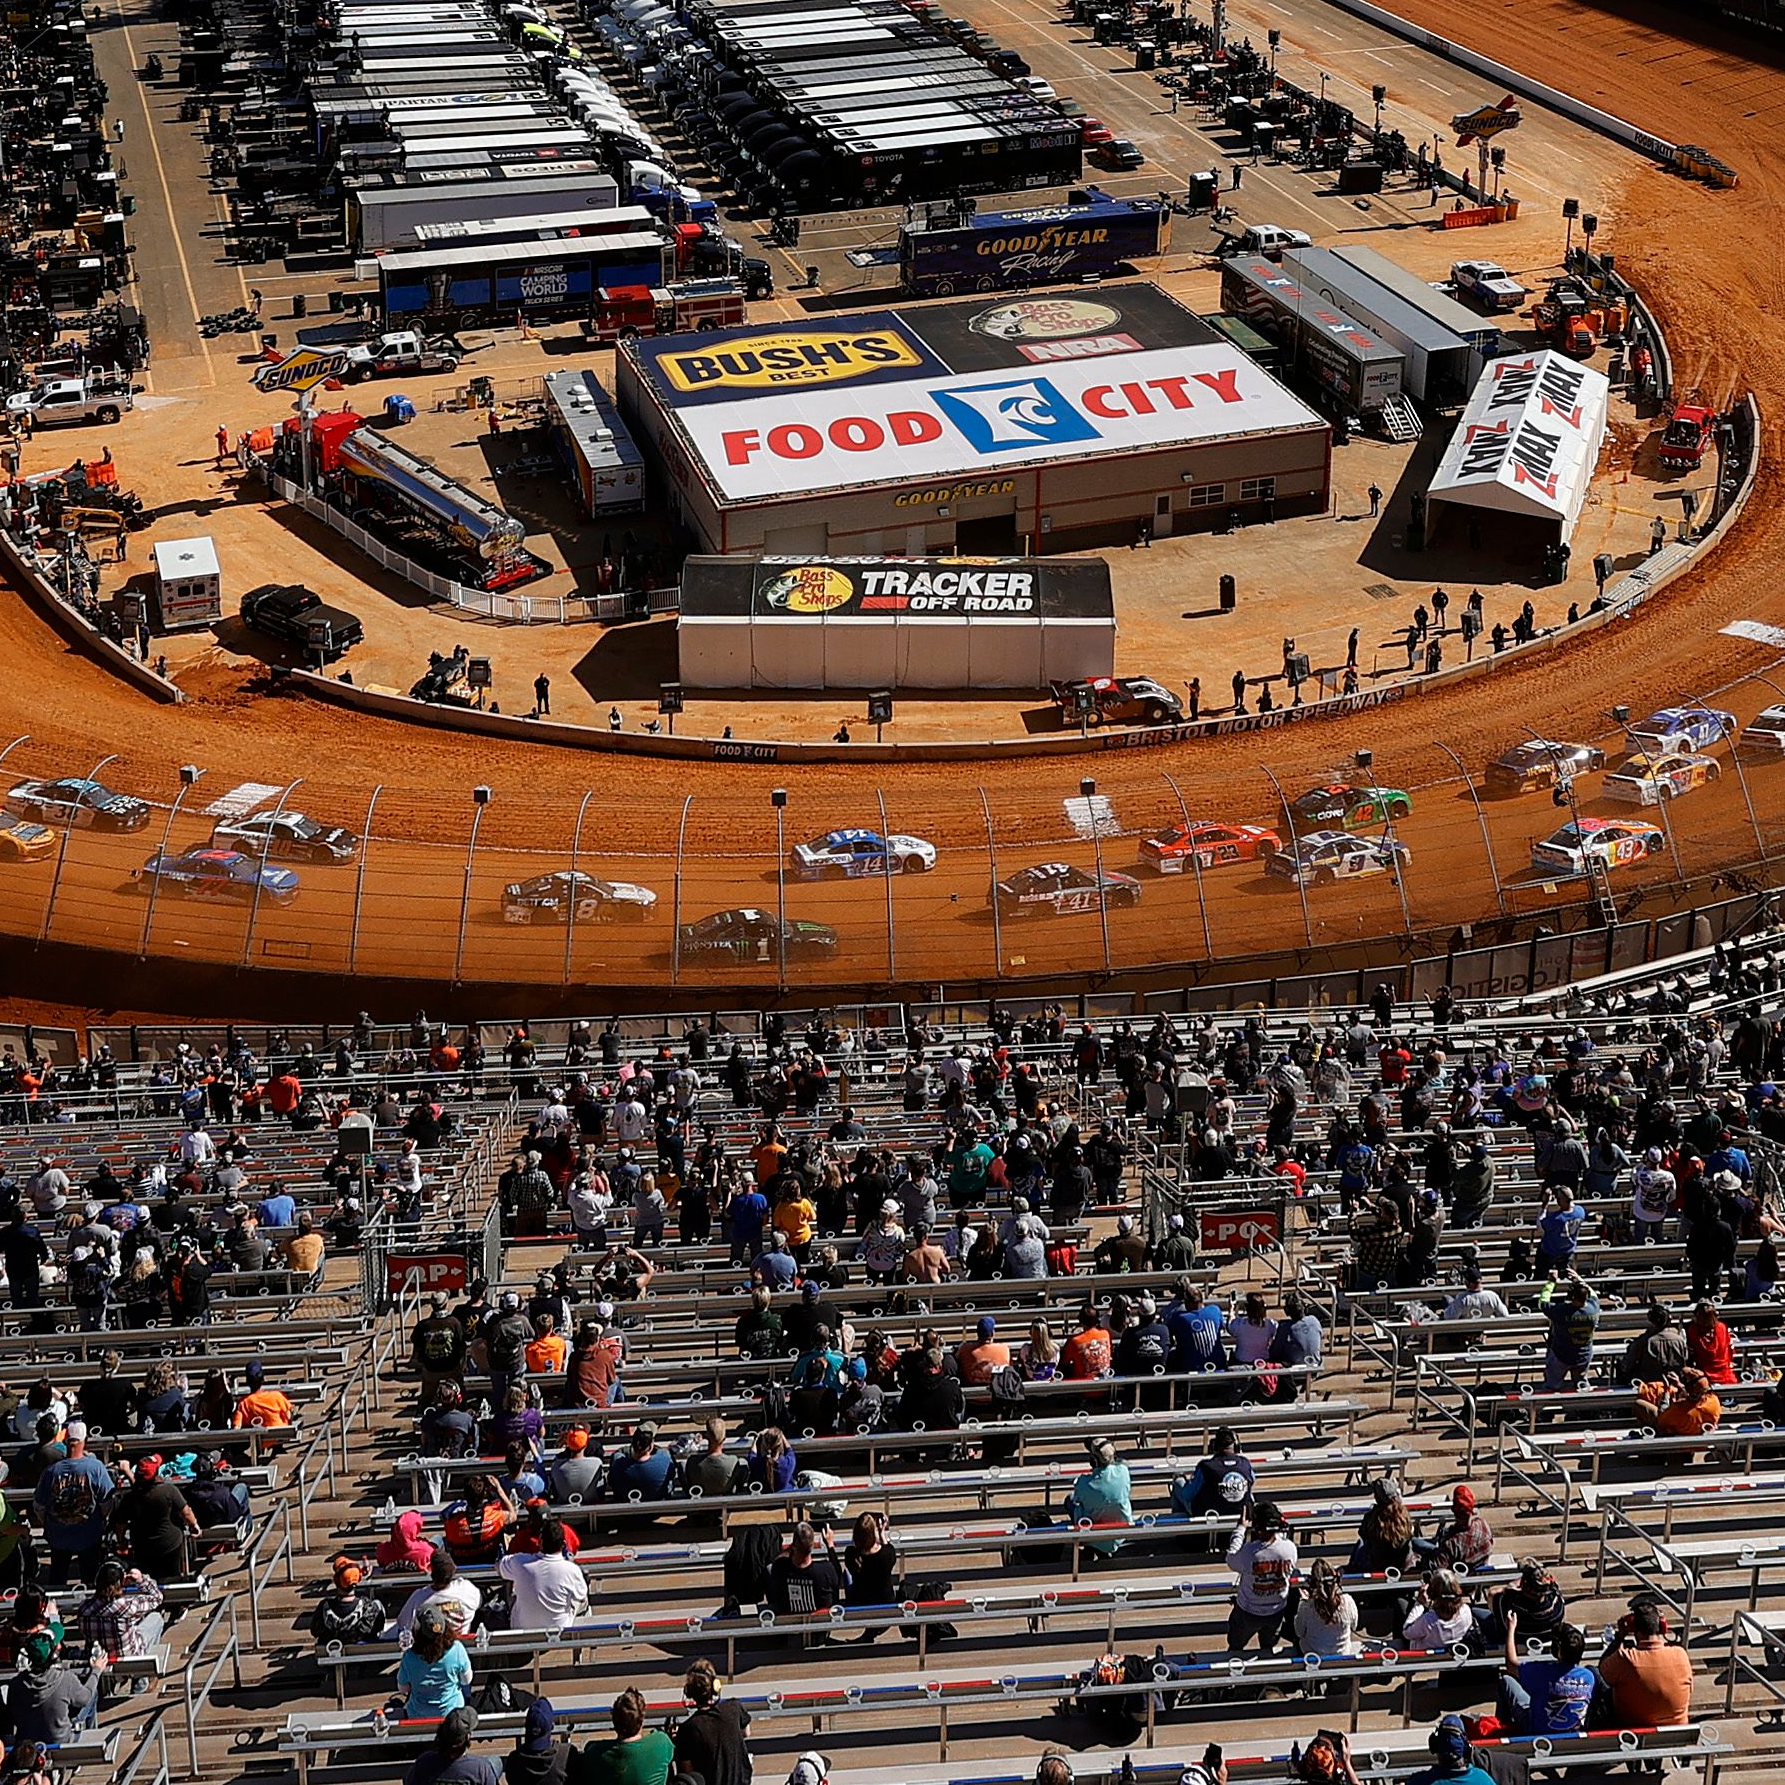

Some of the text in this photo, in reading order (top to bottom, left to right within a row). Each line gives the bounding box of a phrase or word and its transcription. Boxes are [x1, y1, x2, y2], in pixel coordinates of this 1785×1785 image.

[378, 97, 448, 108] SPARTAN
[1030, 135, 1064, 149] Mobil
[492, 150, 537, 159] TOYOTA
[874, 153, 905, 163] TOYOTA
[511, 164, 576, 174] ENEOS
[891, 173, 902, 185] 4
[976, 226, 1110, 256] GOODYEAR
[532, 265, 564, 275] NASCAR
[999, 248, 1082, 277] Racing
[519, 273, 568, 287] CAMPING
[519, 282, 568, 297] WORLD
[1019, 301, 1075, 316] Bass
[1037, 315, 1109, 335] Shops
[747, 340, 777, 349] SINCE
[1027, 336, 1129, 360] NRA
[674, 335, 903, 386] BUSH'S
[264, 354, 346, 388] SUNOCO
[768, 367, 831, 383] BEST
[1534, 358, 1586, 431] ZMAX
[722, 369, 1245, 466] FOOD CITY
[1508, 418, 1563, 501] ZMAX
[895, 480, 1015, 508] GOODYEAR
[799, 568, 835, 583] Bass
[861, 570, 1034, 597] TRACKER
[801, 581, 826, 596] Pro
[797, 591, 844, 608] Shops
[909, 597, 1034, 612] OFF ROAD
[1126, 690, 1387, 746] BRISTOL MOTOR SPEEDWAY
[715, 744, 777, 756] FOOD CITY
[1317, 808, 1345, 822] clover
[1354, 805, 1373, 821] 42
[1617, 837, 1634, 855] 43
[861, 855, 882, 874] 14
[576, 897, 600, 919] 8
[1069, 893, 1092, 910] 41
[683, 939, 732, 953] MONSTER
[756, 937, 771, 962] 1
[1218, 1221, 1259, 1242] PO
[405, 1264, 449, 1284] QP
